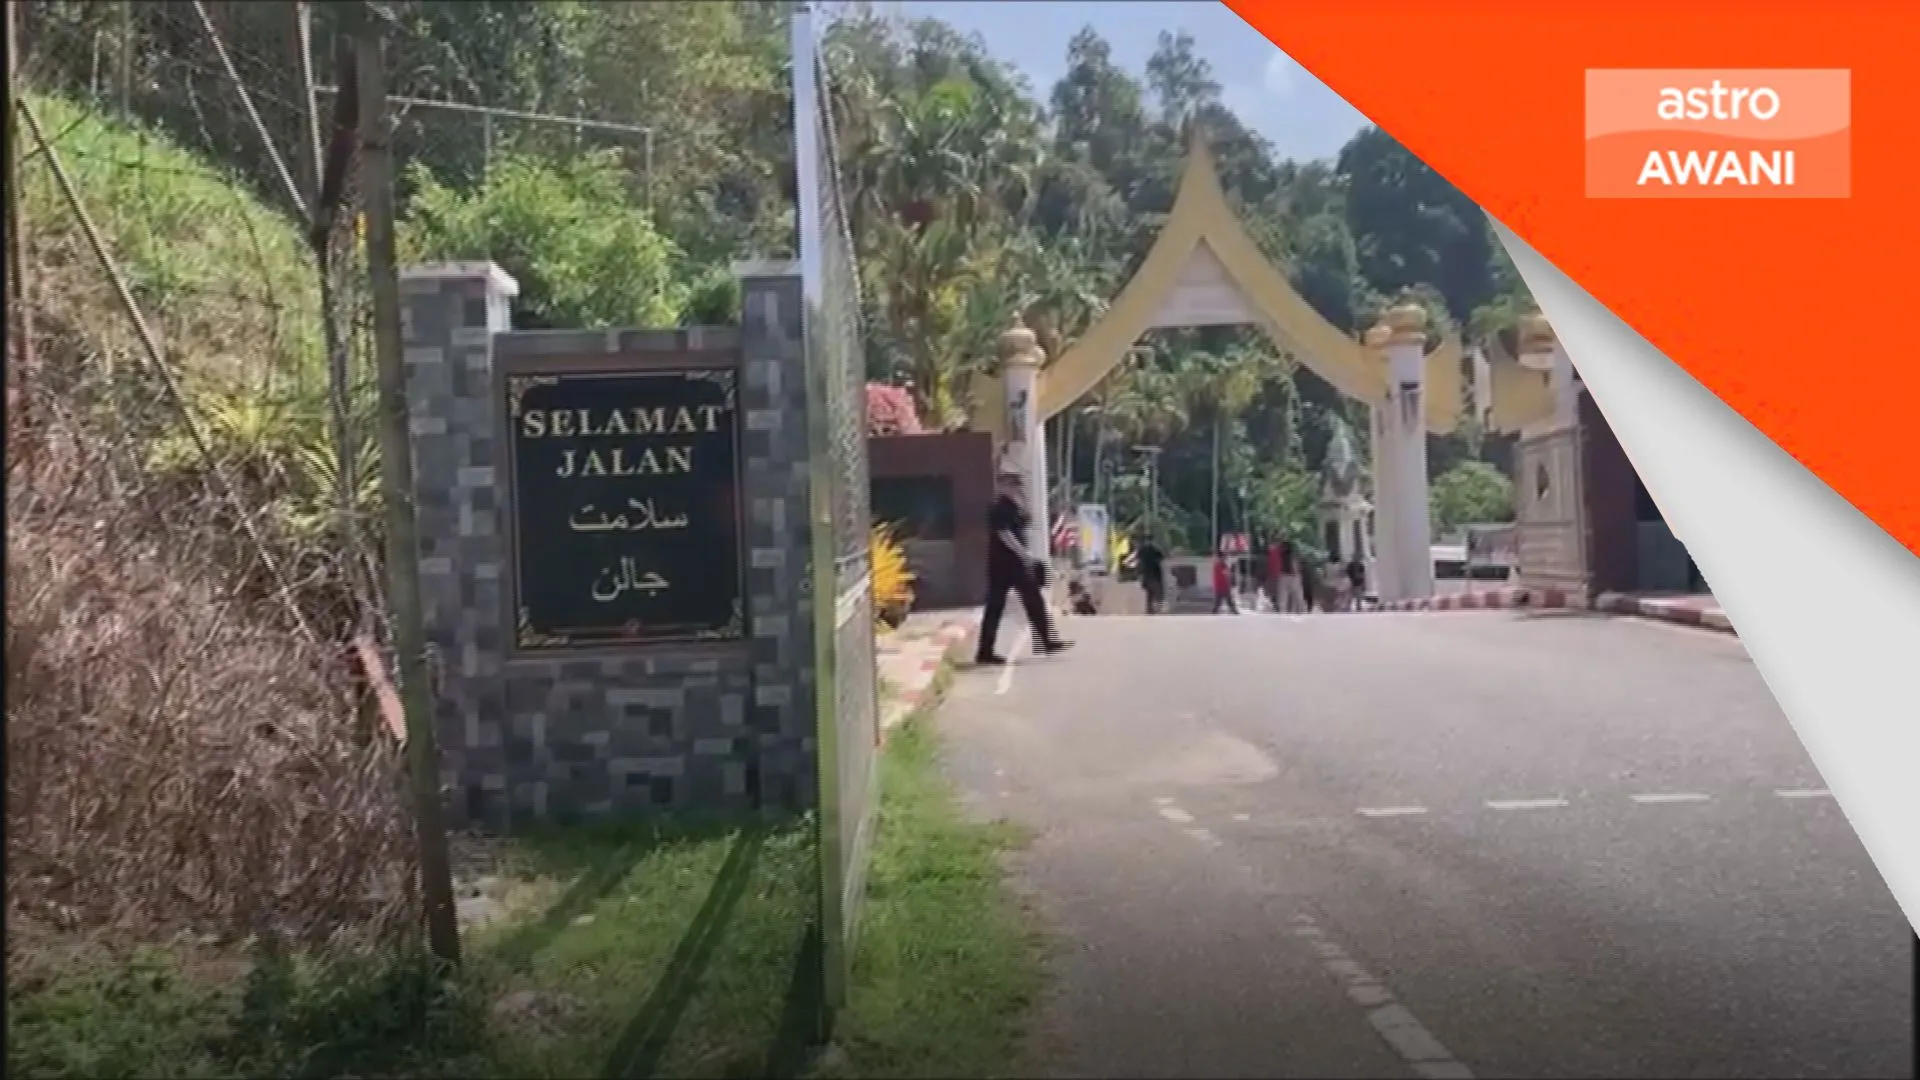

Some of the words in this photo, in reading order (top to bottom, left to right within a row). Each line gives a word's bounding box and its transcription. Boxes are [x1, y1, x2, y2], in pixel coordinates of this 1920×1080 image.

[522, 404, 723, 438] SELAMAT
[555, 446, 693, 478] JALAN
[568, 497, 689, 532] سلامت
[591, 556, 670, 602] جالن
